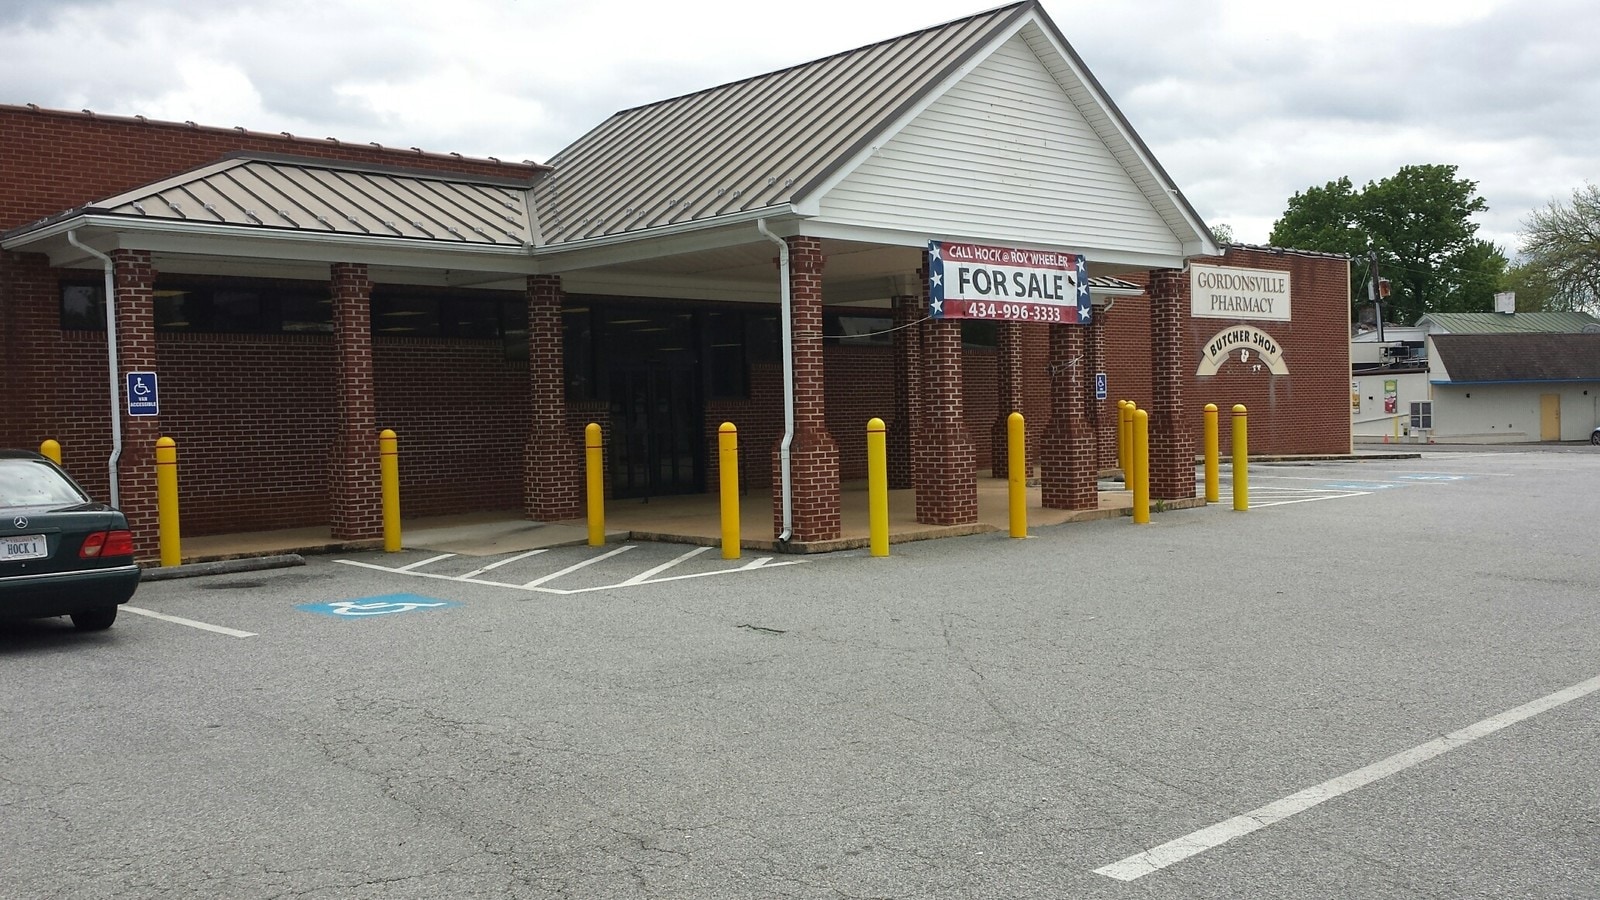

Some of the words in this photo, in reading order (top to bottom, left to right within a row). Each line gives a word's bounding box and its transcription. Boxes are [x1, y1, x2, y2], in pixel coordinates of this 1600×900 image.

[949, 245, 973, 259] CALL
[975, 247, 1001, 261] HOCK
[1002, 252, 1010, 263] @
[1011, 251, 1028, 264] ROY
[1030, 253, 1069, 268] WHEELER
[958, 267, 1009, 296] FOR
[1013, 271, 1063, 300] SALE
[1198, 272, 1285, 294] GORDONSVILLE
[968, 302, 1060, 321] 434-996-3333
[1211, 294, 1274, 313] PHARMACY
[1210, 330, 1250, 356] BUTCHER
[1253, 332, 1276, 354] SHOP
[7, 543, 30, 554] HOCK
[33, 542, 37, 552] 1
